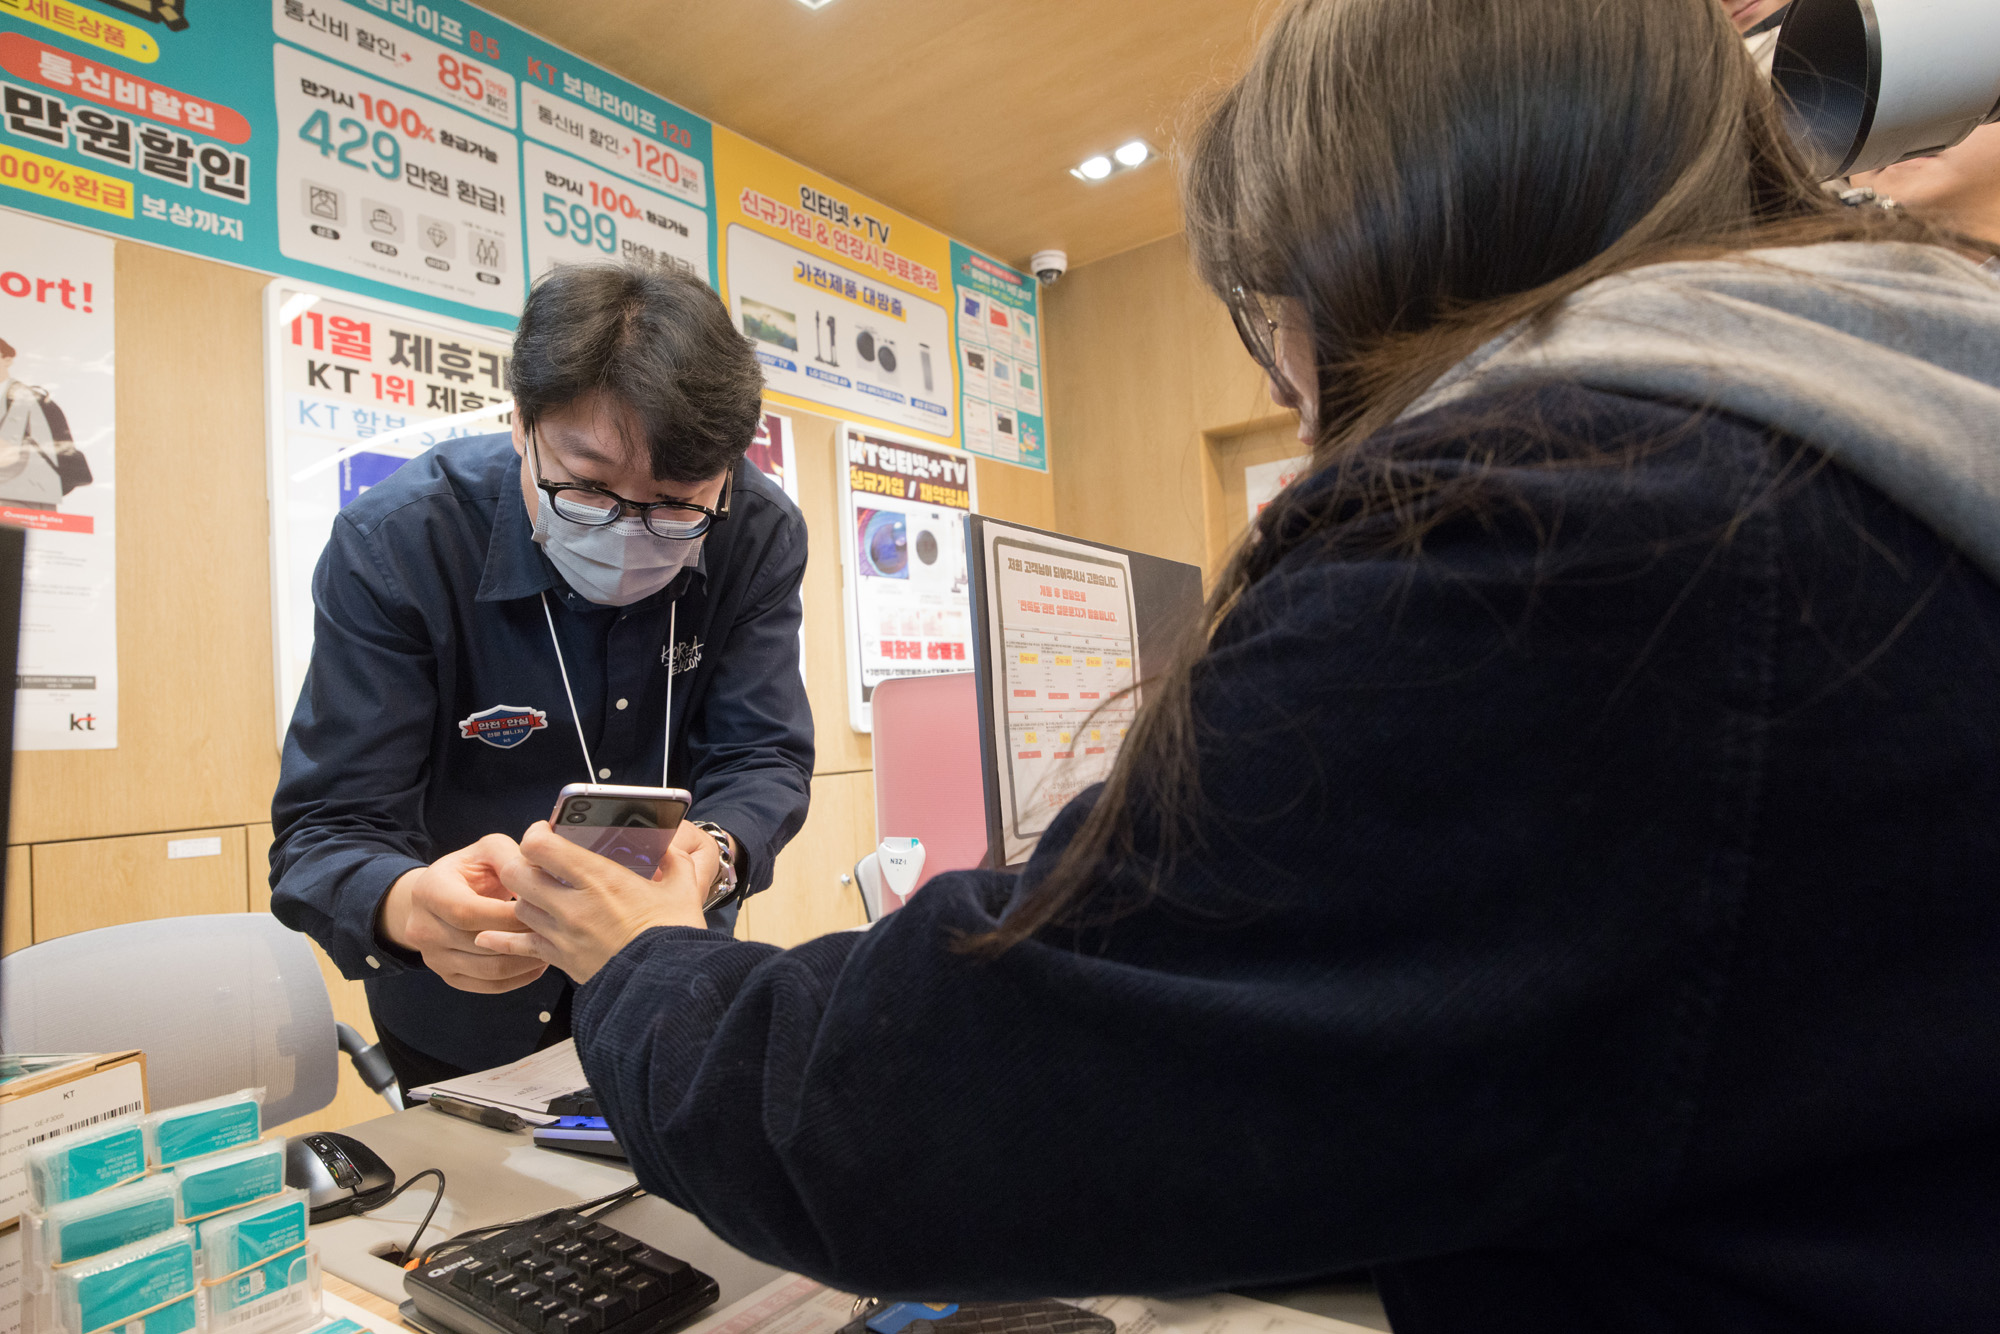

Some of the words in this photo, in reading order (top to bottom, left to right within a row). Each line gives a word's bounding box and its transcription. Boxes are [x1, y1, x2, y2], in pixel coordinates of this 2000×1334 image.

[356, 27, 397, 62] 할인
[38, 50, 216, 131] 통신비할인
[437, 53, 484, 101] 85
[358, 92, 436, 143] 100%
[528, 56, 558, 86] KT
[661, 121, 692, 148] 120
[4, 84, 248, 201] 만원할인
[298, 108, 401, 182] 429
[589, 128, 619, 155] 할인
[632, 137, 680, 184] 120
[405, 162, 451, 198] 만원
[456, 178, 506, 216] 환급!
[589, 180, 644, 221] 100%
[142, 194, 244, 241] 보상까지
[543, 192, 617, 254] 599
[801, 186, 850, 228] 인터넷
[864, 216, 890, 244] TV
[741, 189, 813, 241] 신규가입
[816, 223, 829, 246] &
[833, 228, 880, 268] 연장시
[882, 250, 940, 292] 무료증정
[0, 271, 93, 313] ort!
[797, 260, 857, 300] 가전제품
[863, 286, 903, 318] 대방출
[291, 310, 373, 363] 11월
[307, 359, 360, 395] KT
[371, 372, 415, 407] 1위
[298, 399, 340, 430] KT
[69, 712, 97, 731] kt
[63, 1090, 76, 1101] KT
